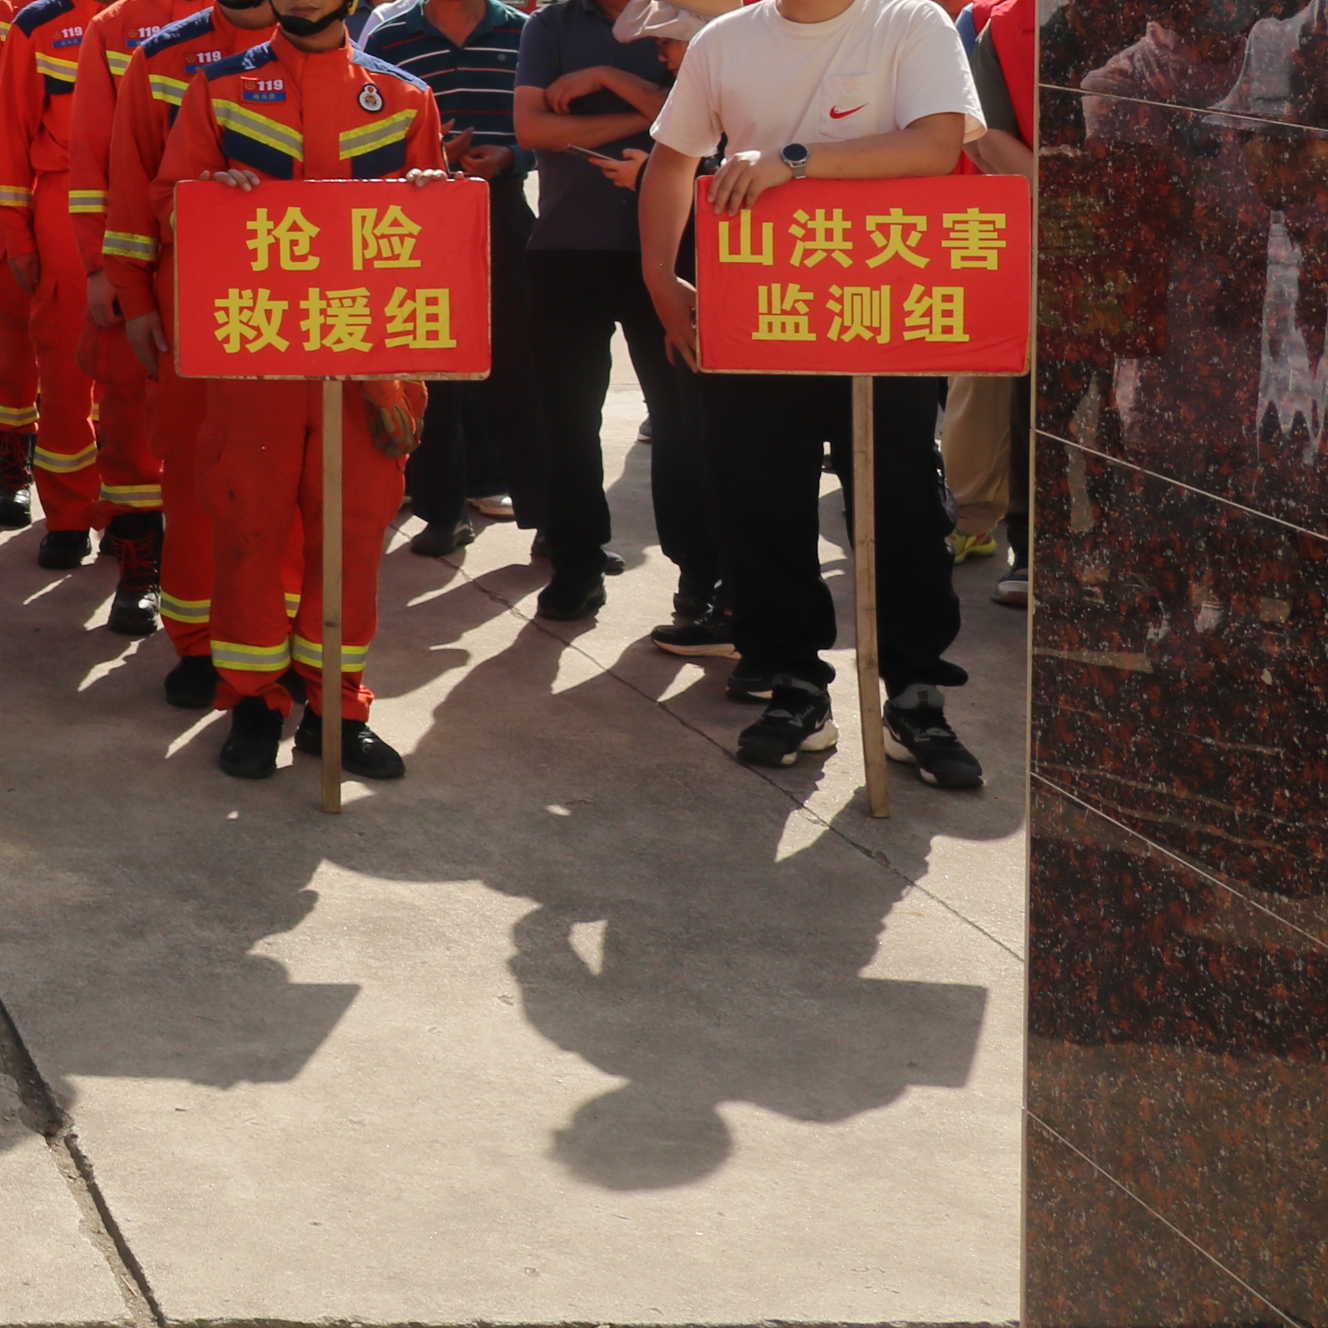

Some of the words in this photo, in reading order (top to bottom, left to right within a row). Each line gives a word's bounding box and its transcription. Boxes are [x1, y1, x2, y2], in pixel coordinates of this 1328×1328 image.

[61, 26, 83, 38] 119
[138, 25, 161, 38] 119
[196, 50, 222, 63] 119
[257, 79, 284, 91] 119
[246, 205, 422, 272] 抢险
[718, 207, 1007, 271] 山洪灾害
[214, 286, 457, 354] 救援组
[752, 283, 970, 344] 监测组
